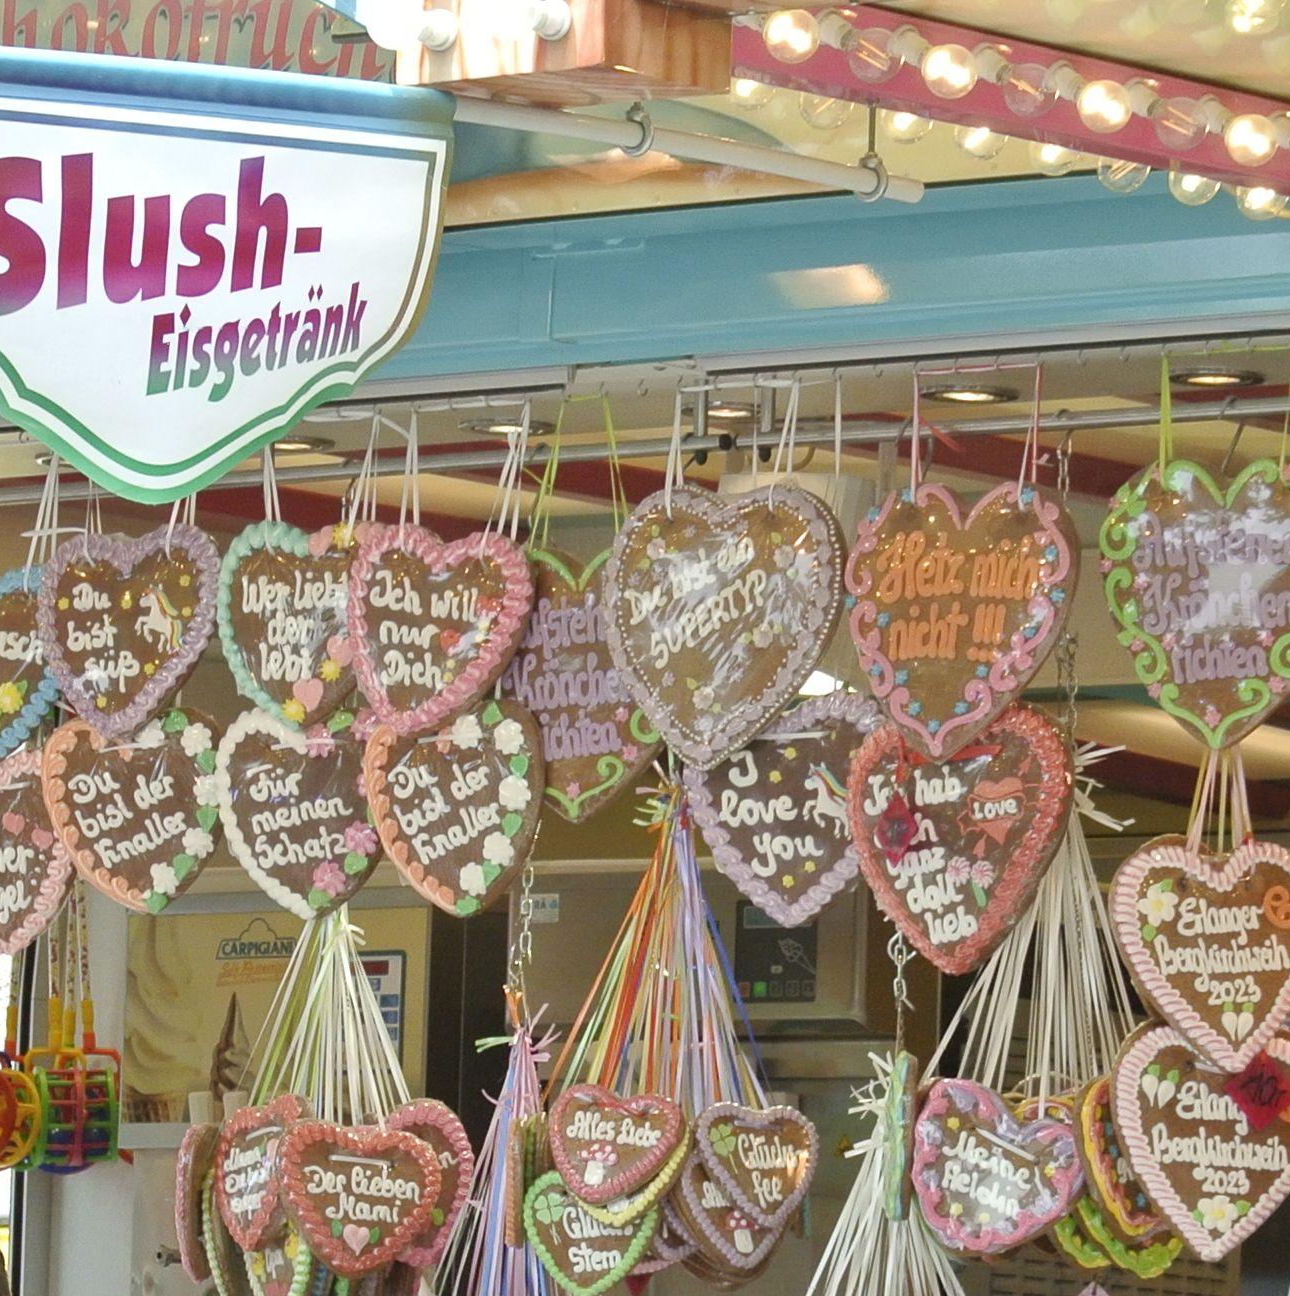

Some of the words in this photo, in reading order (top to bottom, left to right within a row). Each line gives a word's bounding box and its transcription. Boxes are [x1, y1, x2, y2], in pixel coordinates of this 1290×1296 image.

[146, 281, 368, 402] Eisgetränk
[970, 534, 1041, 600] mich
[73, 582, 112, 613] Du
[242, 574, 290, 614] Wer
[369, 570, 422, 614] Ich
[431, 587, 480, 623] will
[624, 586, 667, 625] Du
[66, 621, 118, 653] bist
[267, 612, 314, 647] der
[379, 620, 442, 650] nur
[649, 568, 767, 669] SUPERTYP
[888, 601, 970, 661] nicht
[84, 652, 140, 693] süß
[259, 643, 312, 682] lebt
[382, 649, 443, 693] Dich
[1171, 631, 1269, 684] richten
[67, 771, 121, 804] Du
[249, 762, 303, 801] Für
[387, 764, 439, 800] Du
[393, 790, 451, 836] bist
[451, 764, 490, 801] der
[914, 767, 967, 807] hab
[74, 798, 133, 839] bist
[133, 773, 175, 807] der
[251, 795, 353, 836] meinen
[719, 789, 799, 828] love
[93, 810, 188, 870] Knaller
[253, 826, 348, 870] Schatz
[411, 800, 500, 866] Knaller
[750, 832, 824, 878] you
[905, 874, 965, 913] doll
[927, 905, 978, 945] lieb
[1176, 896, 1265, 946] Erlanger
[1154, 934, 1290, 992] Bergkirchweih
[1207, 975, 1262, 1005] 2023
[567, 1111, 615, 1140] Alles
[942, 1131, 1031, 1190] Meine
[1201, 1166, 1250, 1195] 2023
[303, 1165, 347, 1194] Der
[351, 1166, 420, 1204] lieben
[751, 1171, 783, 1208] fee
[325, 1192, 399, 1223] Mami
